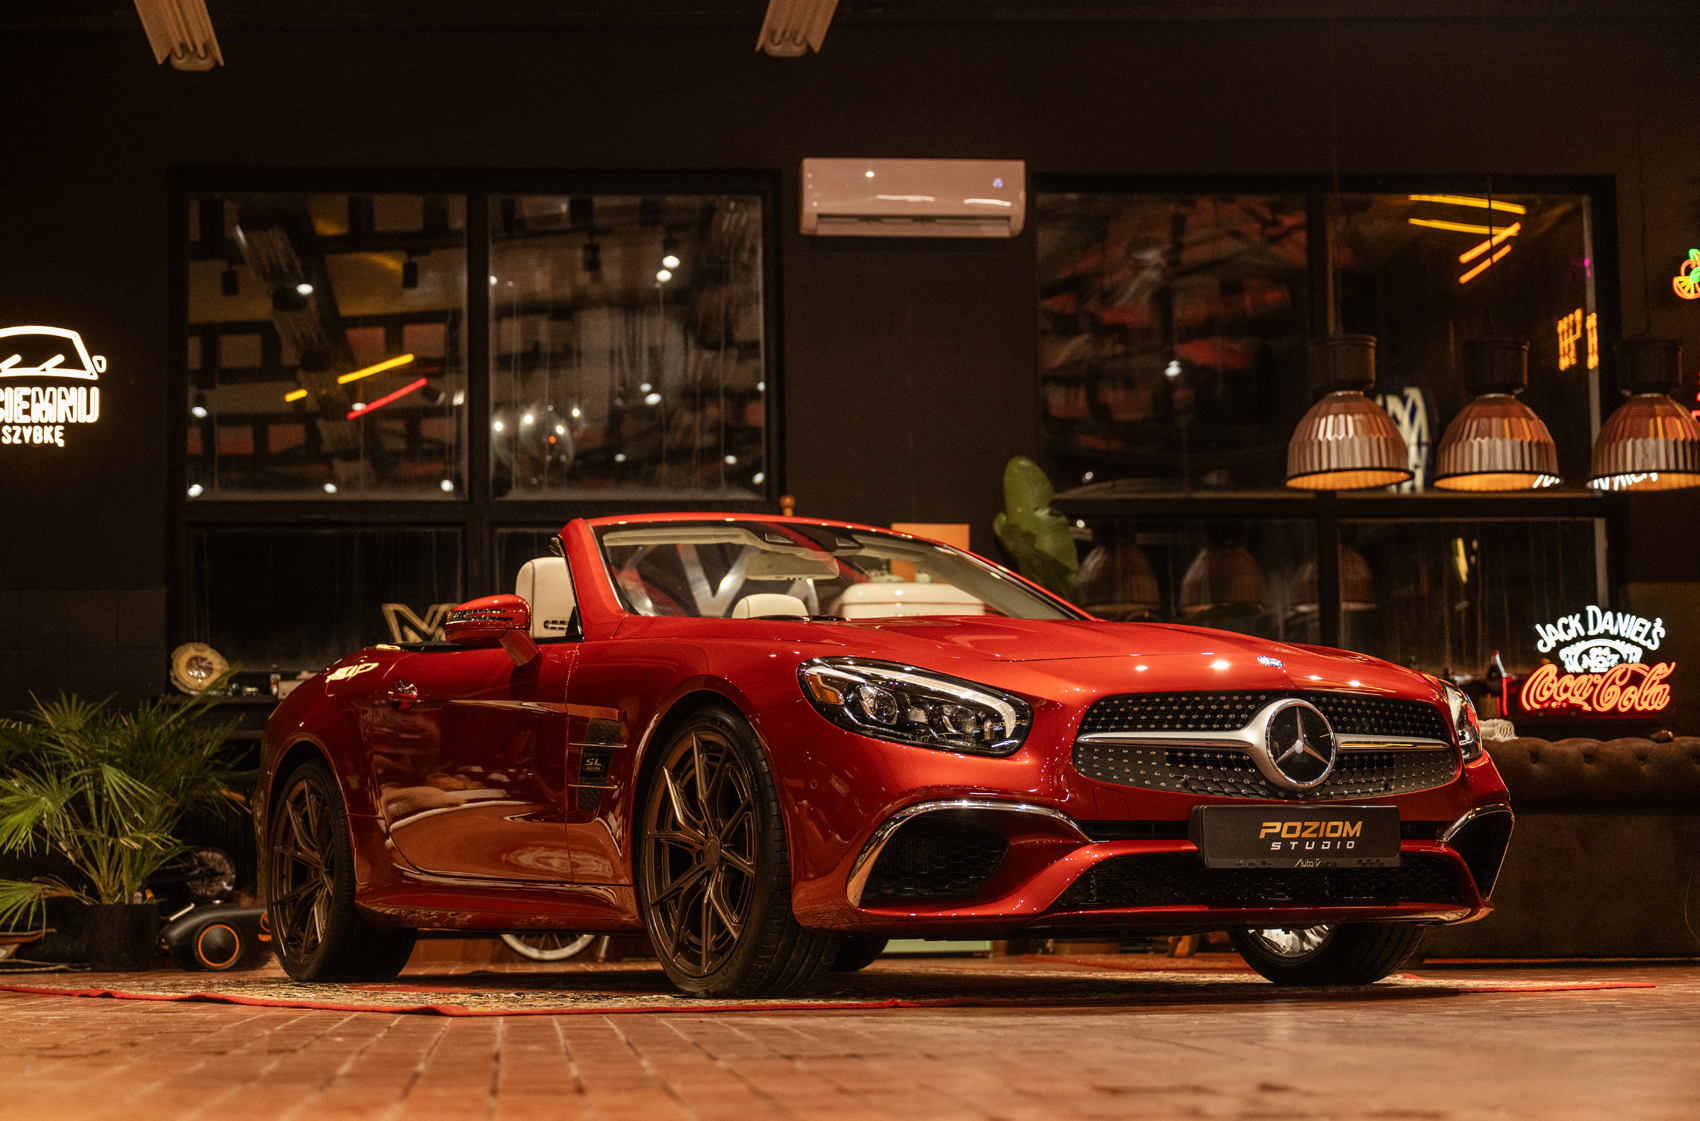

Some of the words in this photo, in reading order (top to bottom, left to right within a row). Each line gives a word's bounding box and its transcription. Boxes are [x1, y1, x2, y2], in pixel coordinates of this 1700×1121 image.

[1, 425, 65, 448] SZYBKĘ
[1535, 613, 1586, 653] JACK
[1585, 604, 1666, 651] DANIEL'S
[584, 757, 602, 766] SL
[1259, 820, 1363, 839] POZIOM
[1270, 840, 1355, 850] STUDIO
